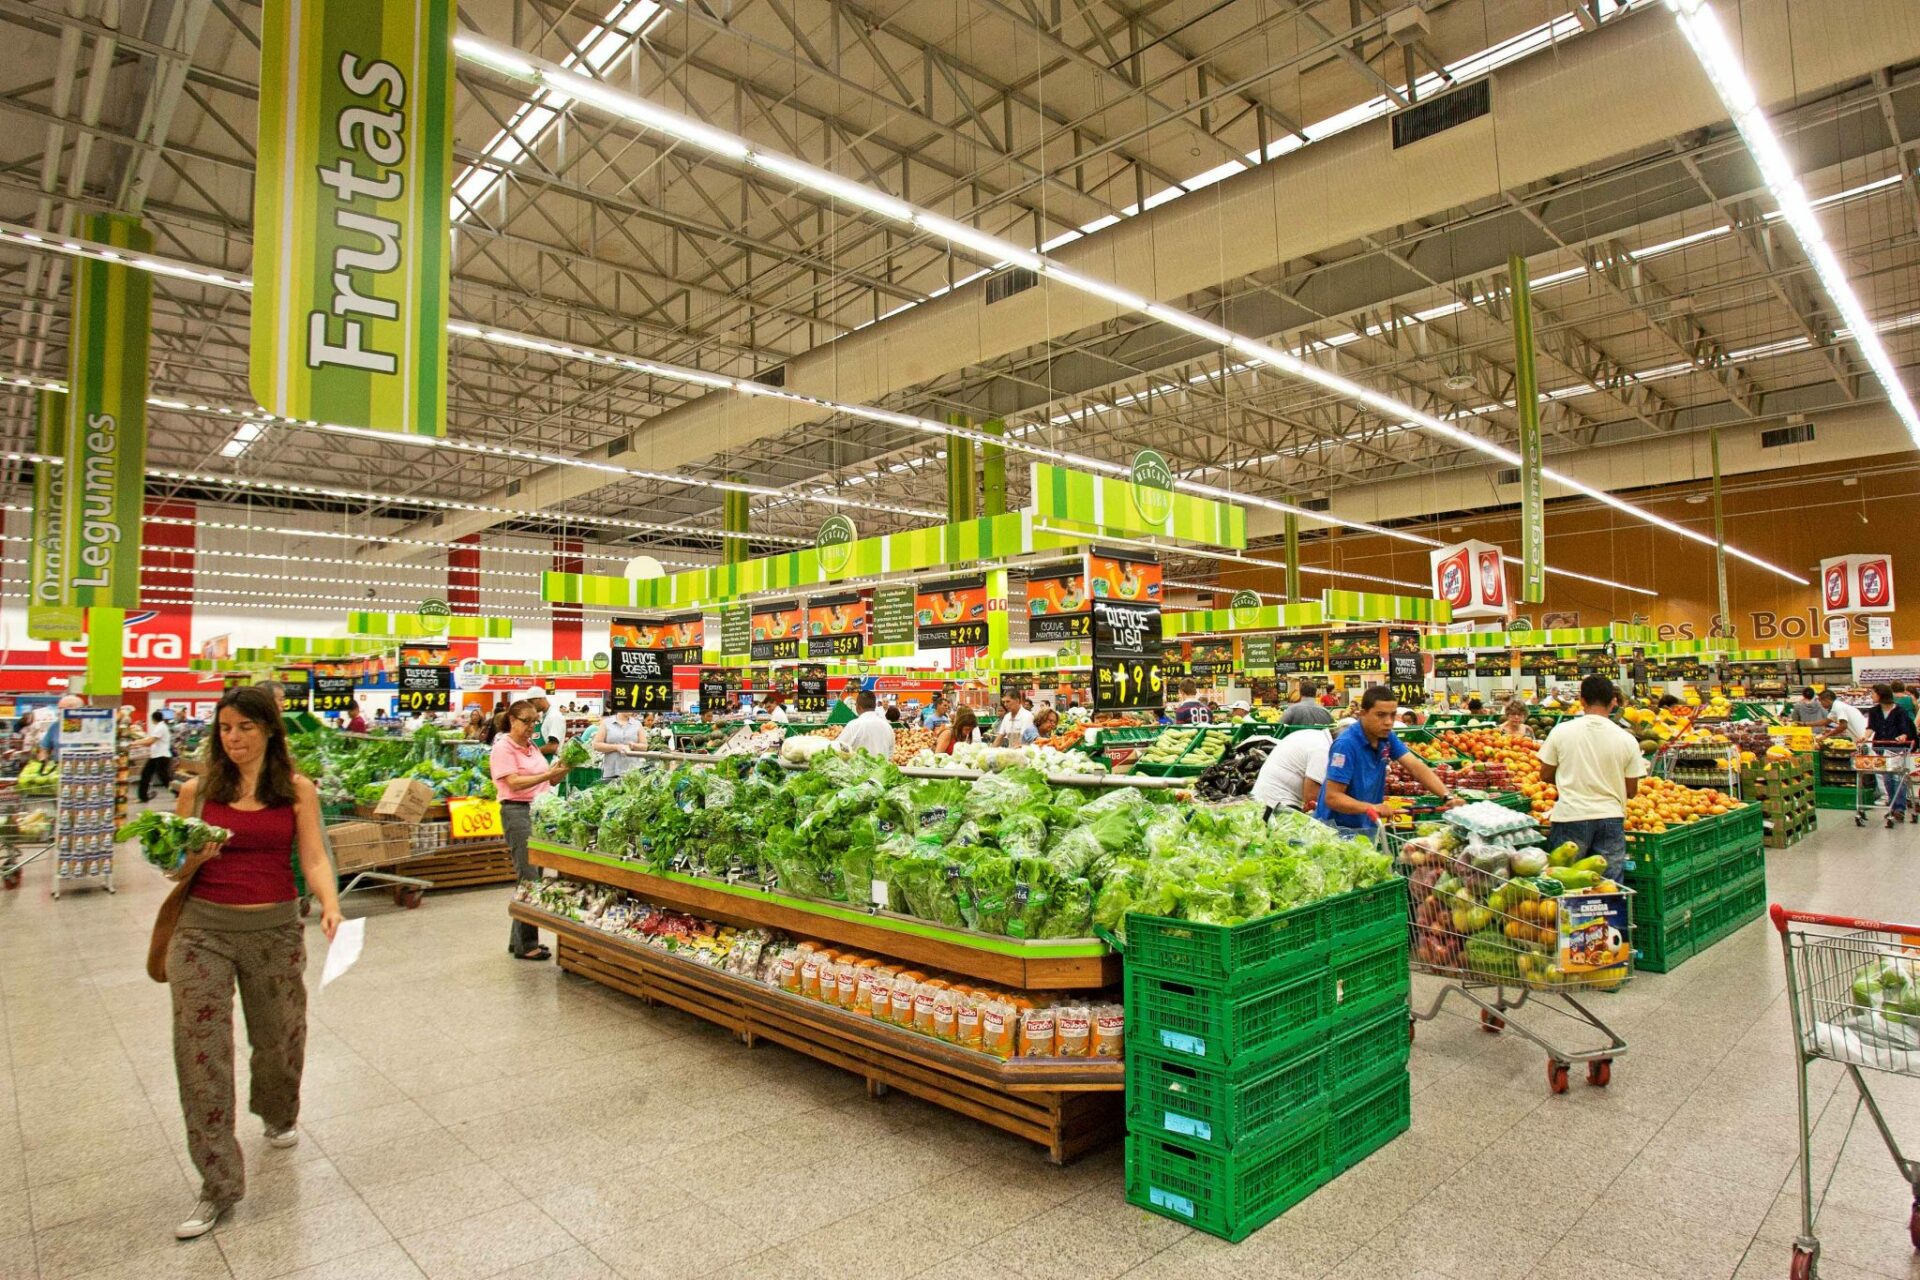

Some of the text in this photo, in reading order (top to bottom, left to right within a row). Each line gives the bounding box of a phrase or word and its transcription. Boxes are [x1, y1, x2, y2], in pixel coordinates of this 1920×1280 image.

[306, 50, 408, 375] Frutas
[1136, 468, 1171, 489] MERCADO
[72, 412, 122, 590] Legumes
[1528, 429, 1542, 585] Legumes
[38, 467, 64, 602] Orgânicos
[1040, 622, 1065, 631] COUVE
[1082, 617, 1089, 635] 2
[1750, 607, 1870, 640] Bolos
[1113, 629, 1142, 646] LISA
[1100, 668, 1112, 683] R$
[411, 692, 446, 710] 0,98
[615, 684, 668, 708] R$ 1,59
[1190, 707, 1209, 724] 86
[1854, 920, 1880, 929] extra
